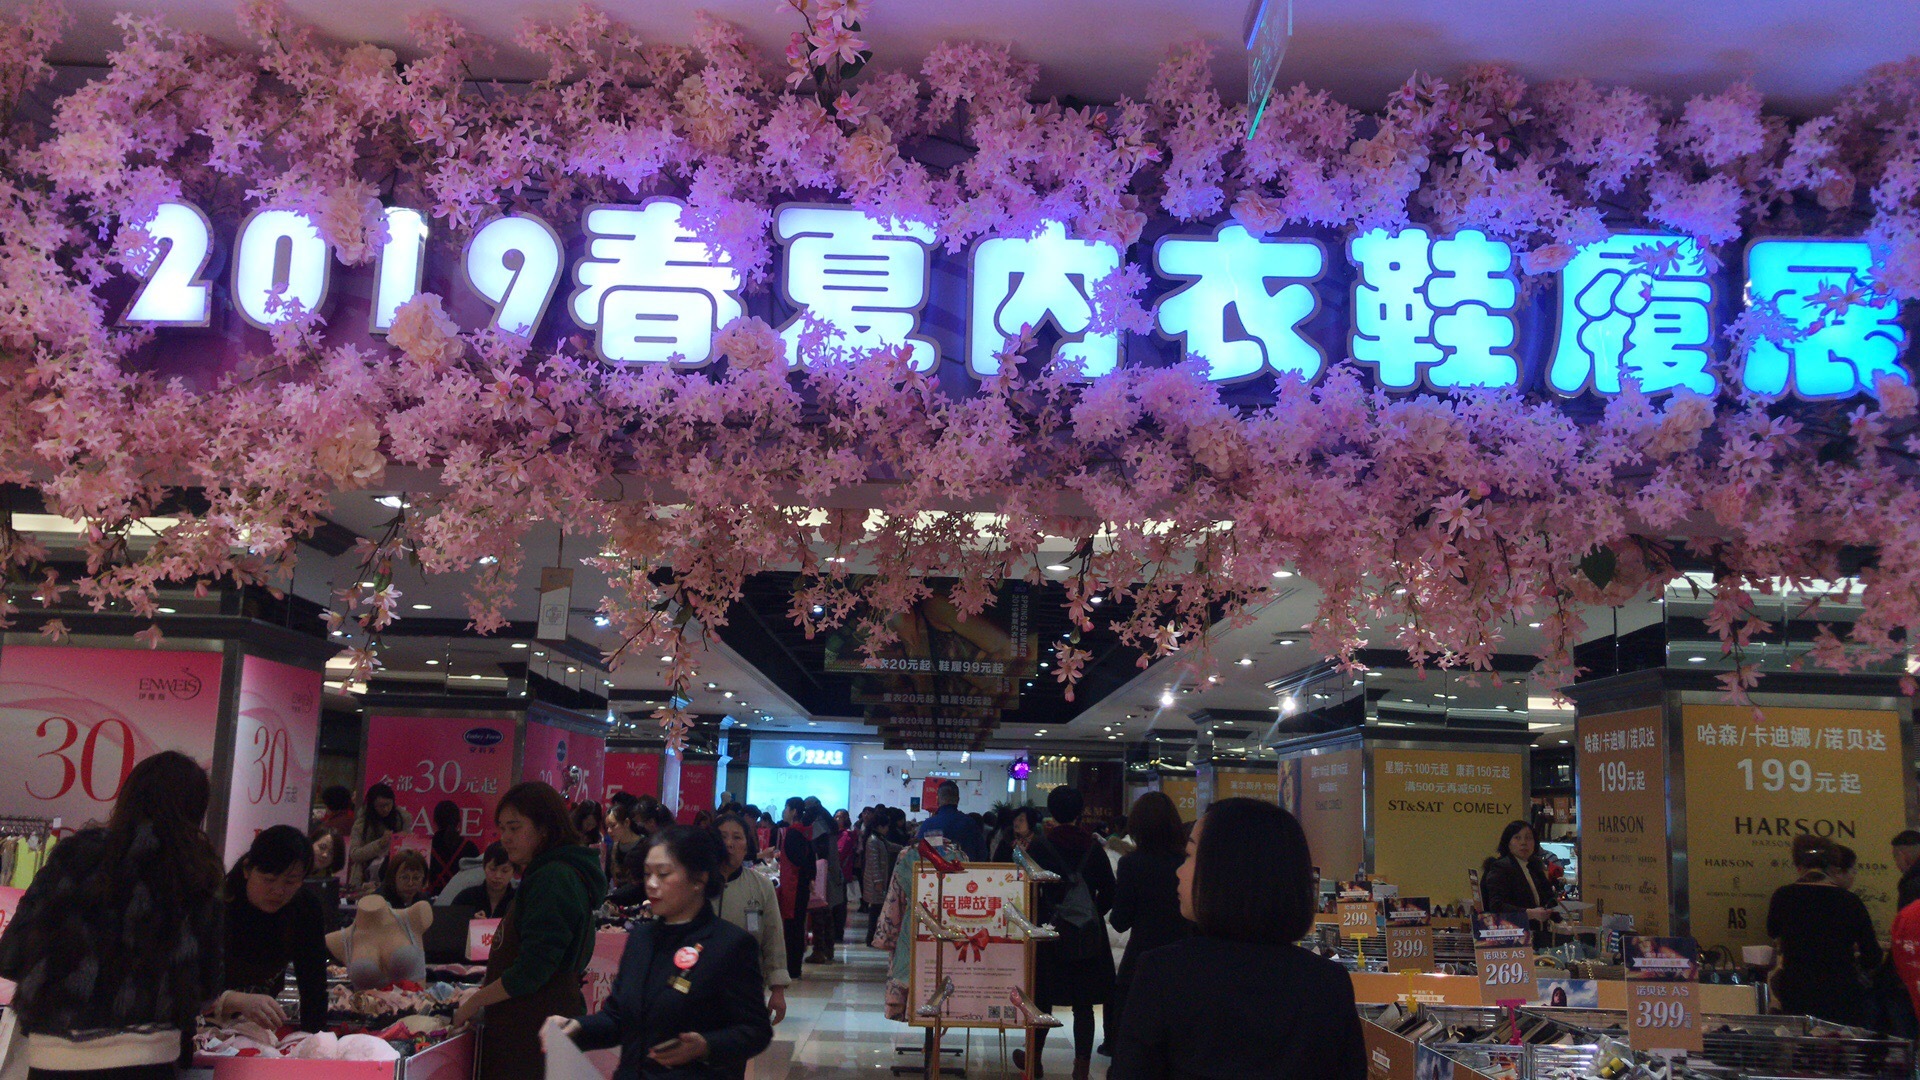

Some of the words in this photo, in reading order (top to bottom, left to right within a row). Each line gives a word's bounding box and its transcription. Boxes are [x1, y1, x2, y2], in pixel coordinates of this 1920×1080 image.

[866, 658, 931, 671] 衣20元起
[1697, 722, 1887, 751] 哈森/卡迪娜/诺贝达
[25, 716, 135, 802] 30
[247, 726, 288, 805] 30
[1598, 760, 1646, 792] 199元起
[1736, 757, 1862, 794] 199元起
[1388, 800, 1444, 813] ST&SAT
[1453, 802, 1512, 815] COMELY
[1598, 815, 1645, 834] HARSON
[1734, 815, 1857, 839] HARSON
[1704, 858, 1754, 869] HARSON
[942, 895, 1002, 911] 品牌故事
[1342, 911, 1368, 927] 299
[1728, 907, 1747, 930] AS
[1392, 939, 1424, 959] 399
[1511, 950, 1526, 959] AS
[1485, 962, 1523, 985] 269
[1671, 986, 1690, 997] AS
[1636, 1000, 1685, 1029] 399
